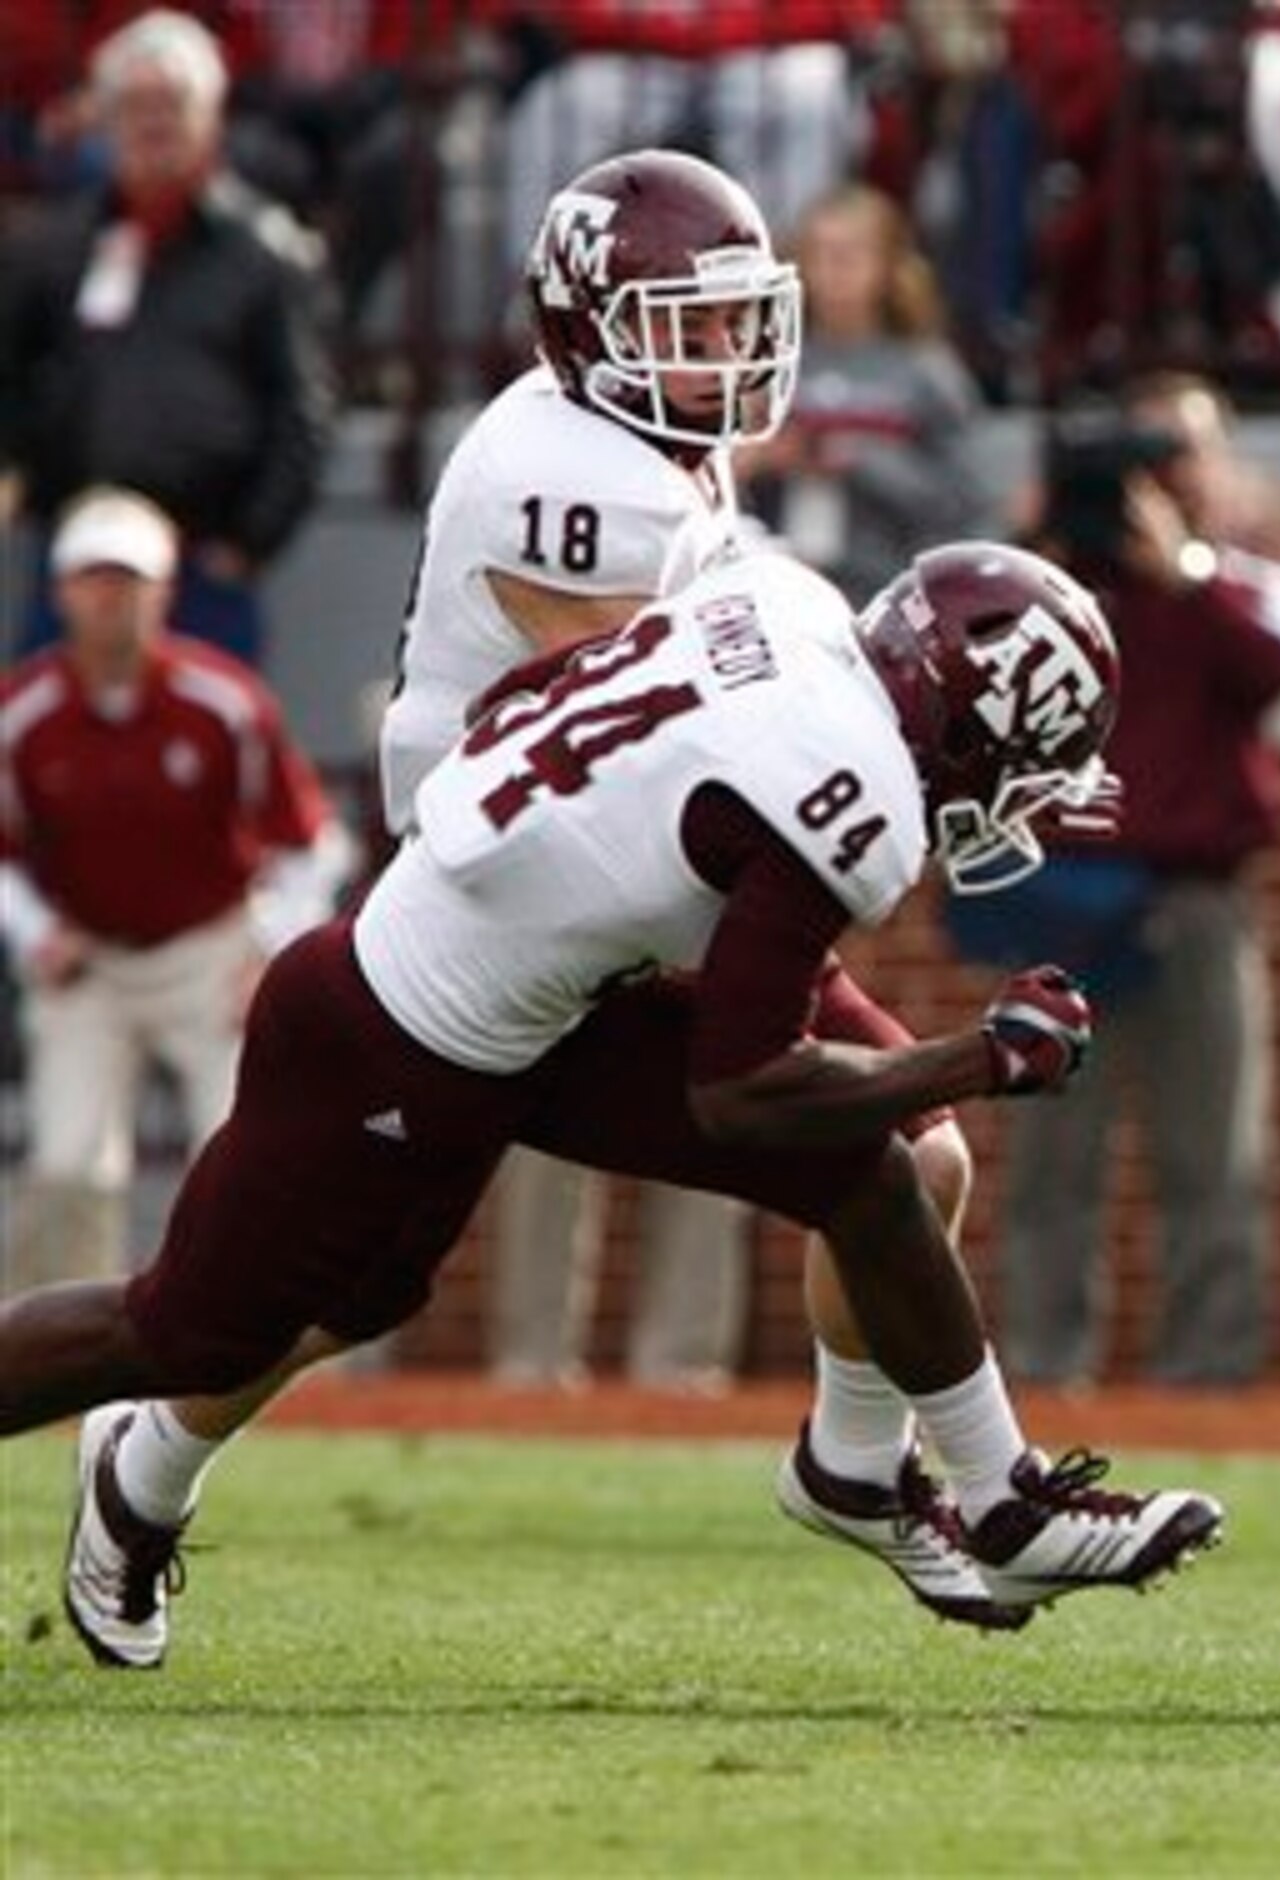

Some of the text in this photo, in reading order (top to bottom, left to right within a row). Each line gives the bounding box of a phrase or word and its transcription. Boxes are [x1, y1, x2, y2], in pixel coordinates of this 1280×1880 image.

[519, 495, 601, 574] 18
[694, 590, 781, 692] ENNEDY
[462, 613, 705, 835] 84
[795, 768, 888, 876] 84
